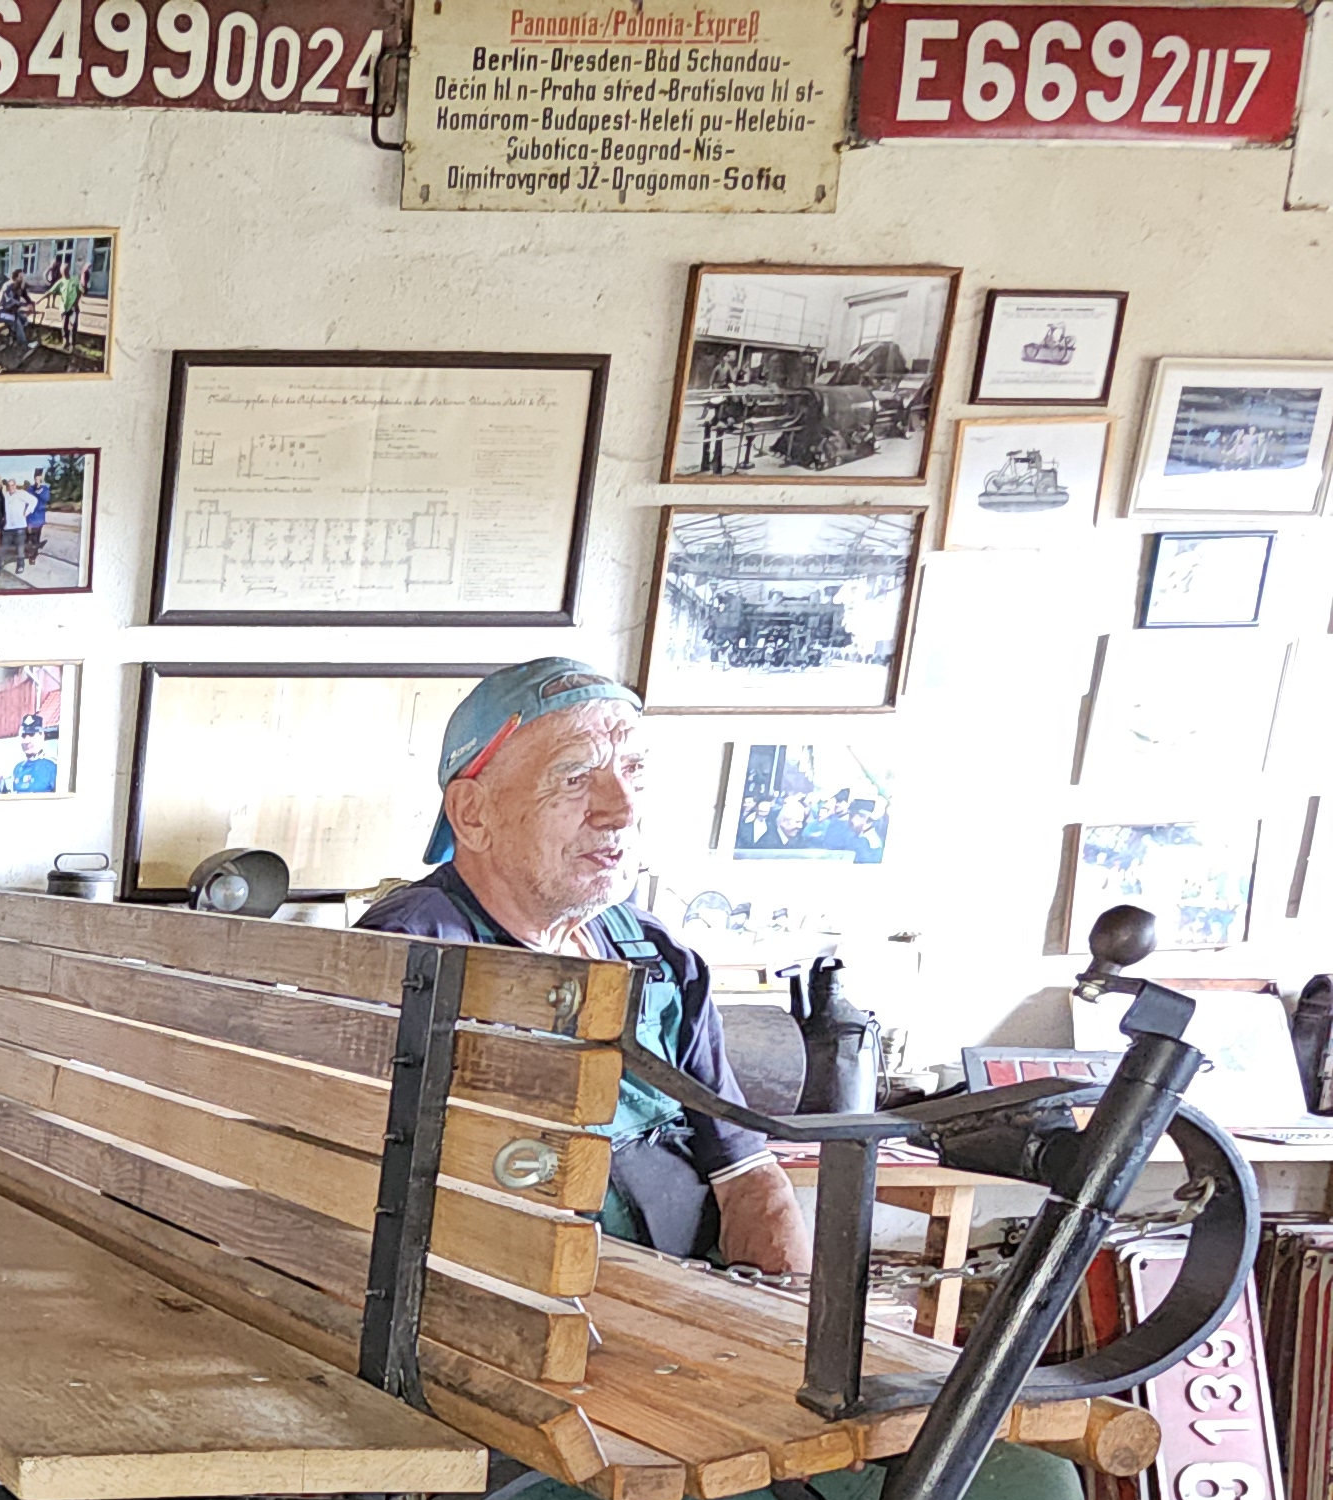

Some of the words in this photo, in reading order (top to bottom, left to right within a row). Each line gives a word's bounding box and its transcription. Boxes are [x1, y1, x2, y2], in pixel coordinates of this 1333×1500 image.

[896, 19, 1271, 124] E6692117
[447, 165, 571, 194] Dimitrovgrad
[1187, 1302, 1255, 1446] 139
